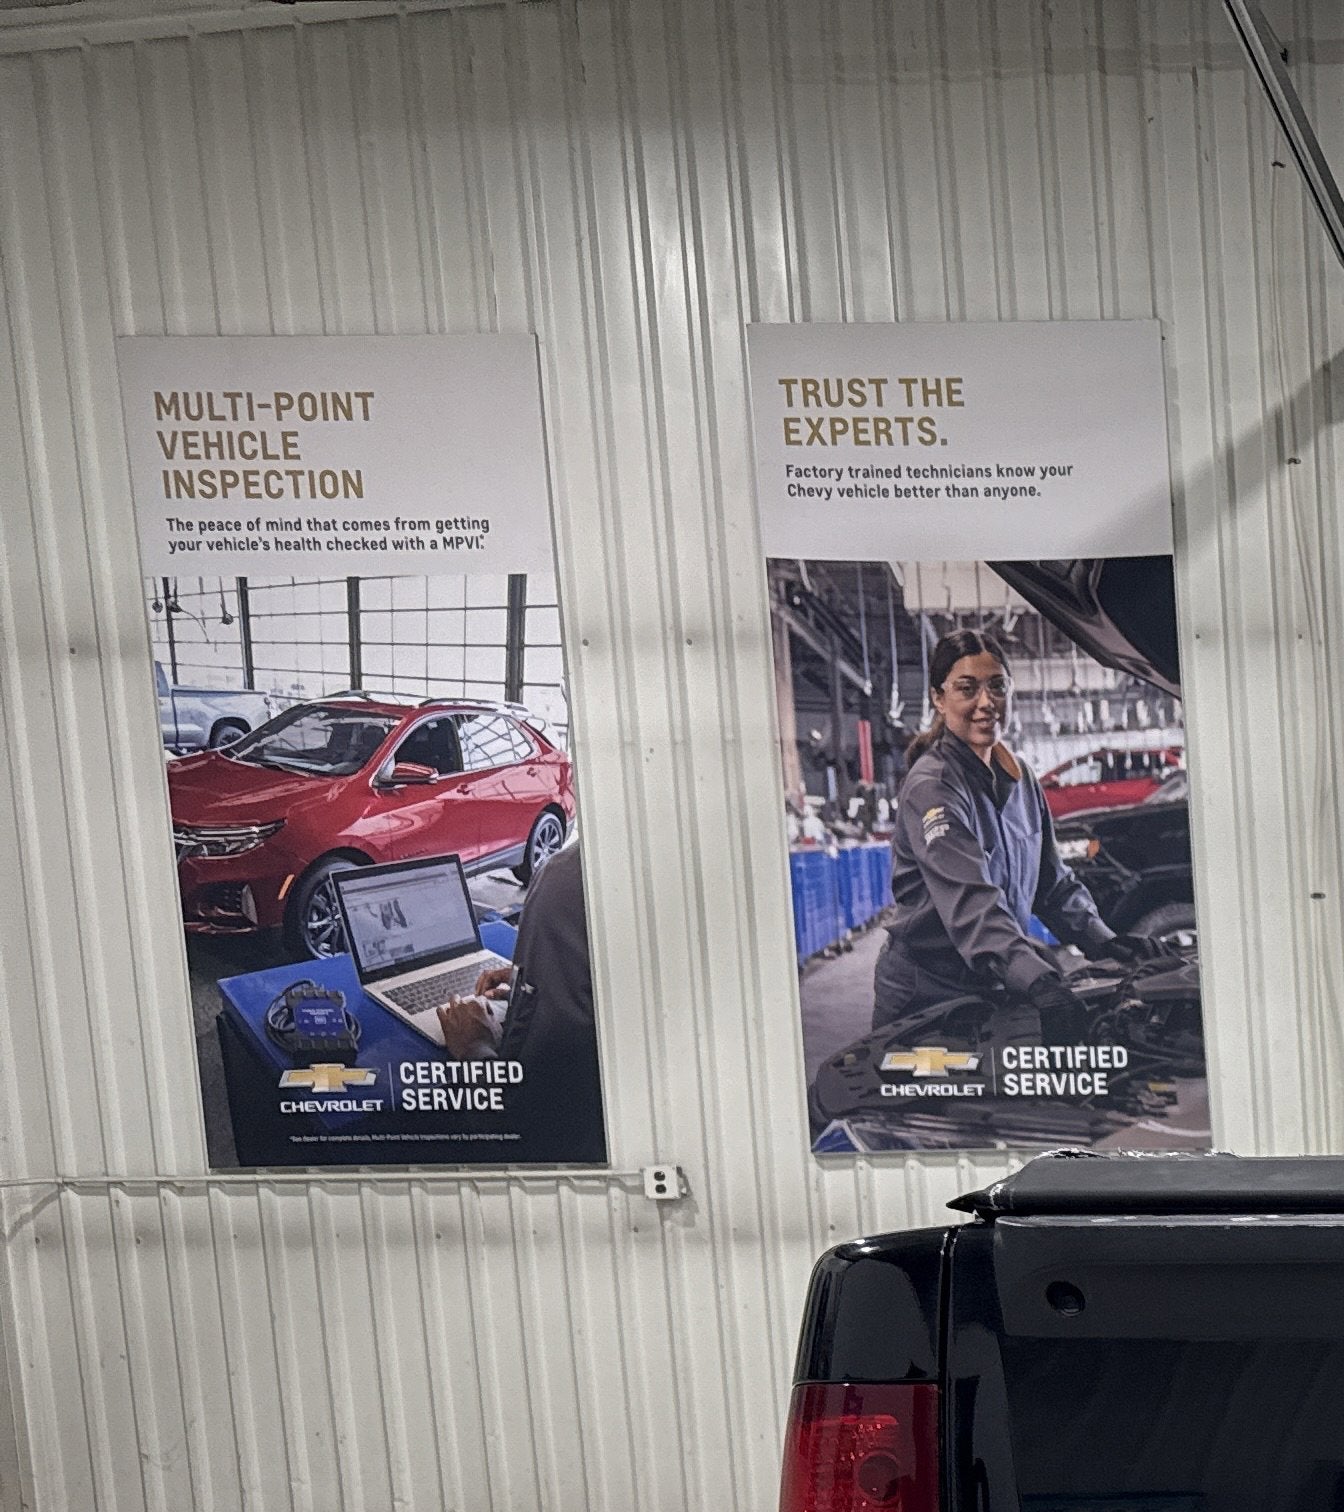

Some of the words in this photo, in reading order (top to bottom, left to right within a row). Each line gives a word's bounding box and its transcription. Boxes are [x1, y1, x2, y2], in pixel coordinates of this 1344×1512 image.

[778, 377, 888, 407] TRUST
[898, 377, 965, 407] THE
[154, 391, 374, 422] MULTI-POINT
[783, 417, 948, 446] EXPERTS.
[157, 431, 301, 460] VEHICLE
[785, 464, 843, 481] Factory
[848, 464, 902, 479] trained
[906, 463, 992, 478] technicians
[996, 463, 1035, 478] know
[1039, 466, 1073, 481] your
[162, 469, 364, 500] INSPECTION
[788, 484, 833, 501] Chevy
[837, 484, 889, 498] vehicle
[895, 484, 941, 498] better
[946, 484, 979, 498] than
[984, 486, 1042, 500] anyone.
[167, 517, 194, 532] The
[198, 521, 242, 535] peace
[247, 517, 261, 532] of
[266, 517, 303, 532] mind
[307, 517, 338, 531] that
[342, 520, 390, 531] comes
[394, 516, 431, 531] from
[436, 517, 490, 534] getting
[169, 539, 202, 554] your
[206, 537, 270, 551] vehicle's
[275, 537, 322, 551] health
[327, 536, 387, 550] checked
[392, 536, 425, 550] with
[430, 539, 438, 549] a
[1002, 1045, 1128, 1068] CERTIFIED
[400, 1060, 524, 1084] CERTIFIED
[881, 1083, 985, 1097] CHEVROLET
[1003, 1073, 1109, 1096] SERVICE
[280, 1099, 384, 1113] CHEVROLET
[402, 1089, 504, 1111] SERVICE
